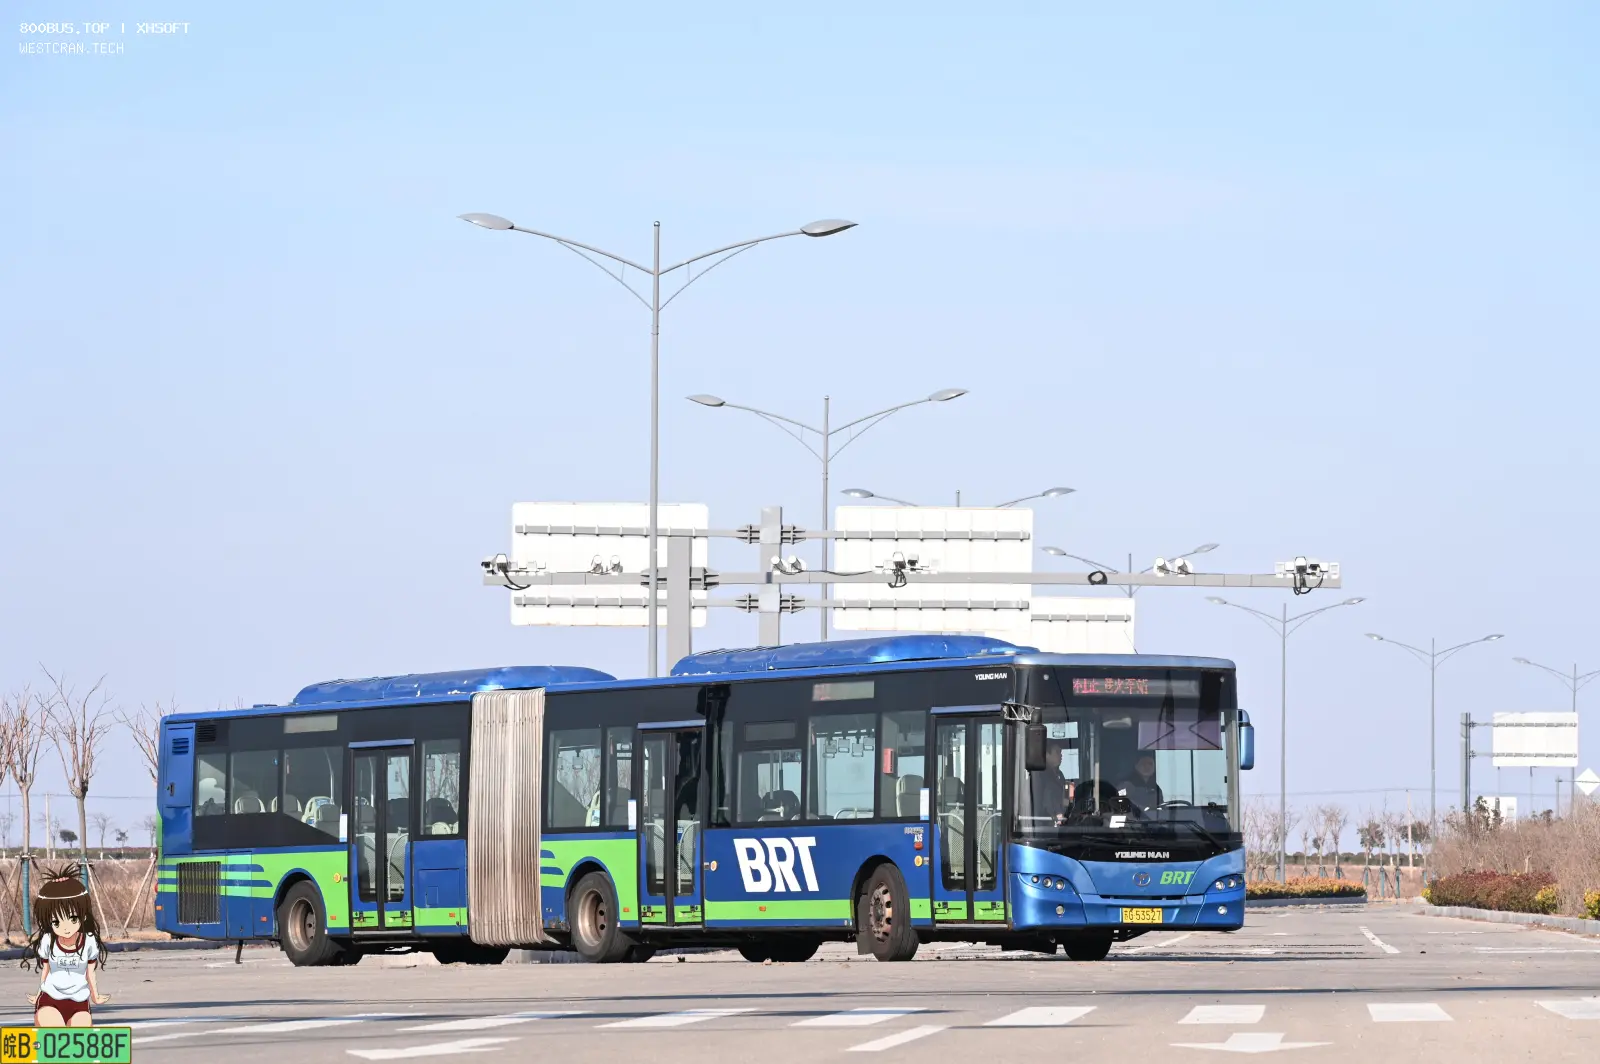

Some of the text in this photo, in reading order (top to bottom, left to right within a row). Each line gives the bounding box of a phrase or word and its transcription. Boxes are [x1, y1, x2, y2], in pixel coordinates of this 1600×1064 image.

[975, 672, 1008, 681] YOUNG MAN
[1115, 851, 1147, 859] YOUNG
[733, 836, 820, 893] BRT
[1160, 871, 1195, 885] BRT
